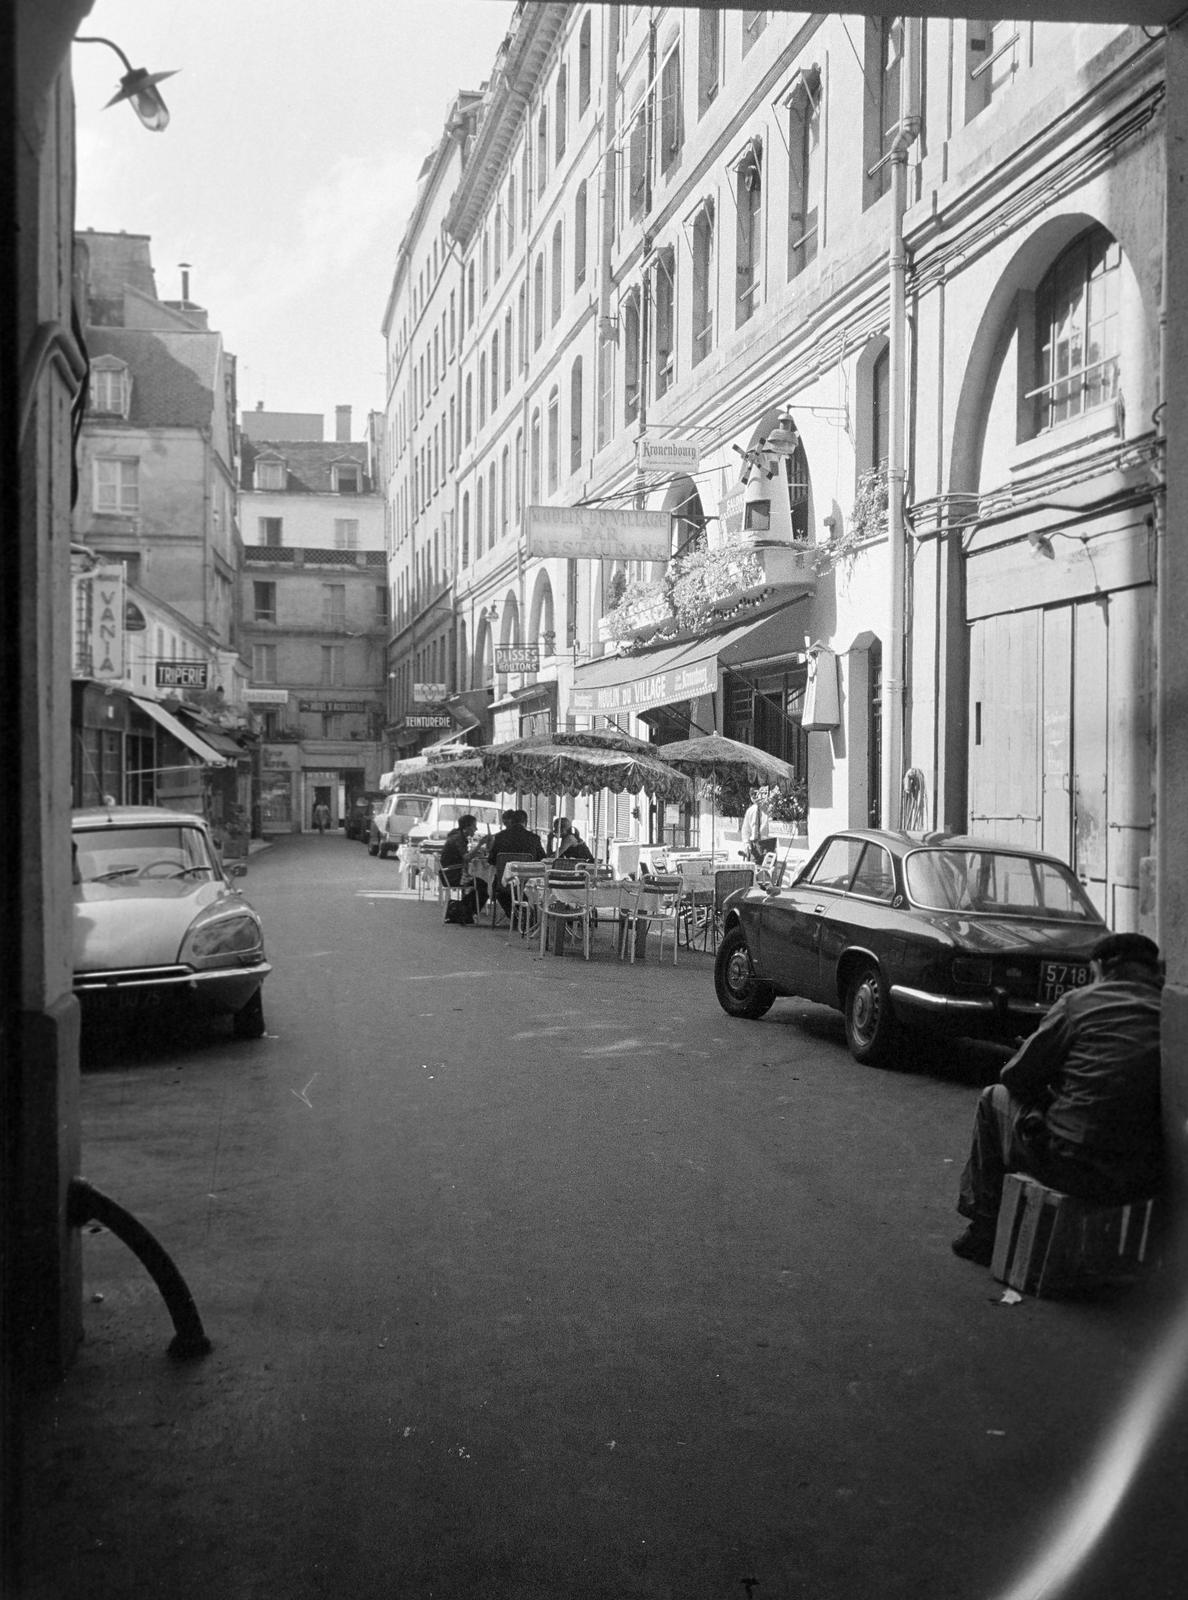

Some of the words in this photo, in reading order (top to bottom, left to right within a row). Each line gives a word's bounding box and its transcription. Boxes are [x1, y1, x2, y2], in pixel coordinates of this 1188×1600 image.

[643, 441, 696, 460] Kronenbourg
[612, 511, 668, 528] VILLAGE
[581, 526, 619, 541] BAR
[99, 591, 116, 672] VANIA
[158, 666, 206, 685] TRIPERIE
[634, 676, 667, 703] VILLAGE
[405, 716, 451, 728] TEINTURERIE
[1046, 964, 1087, 984] 5718
